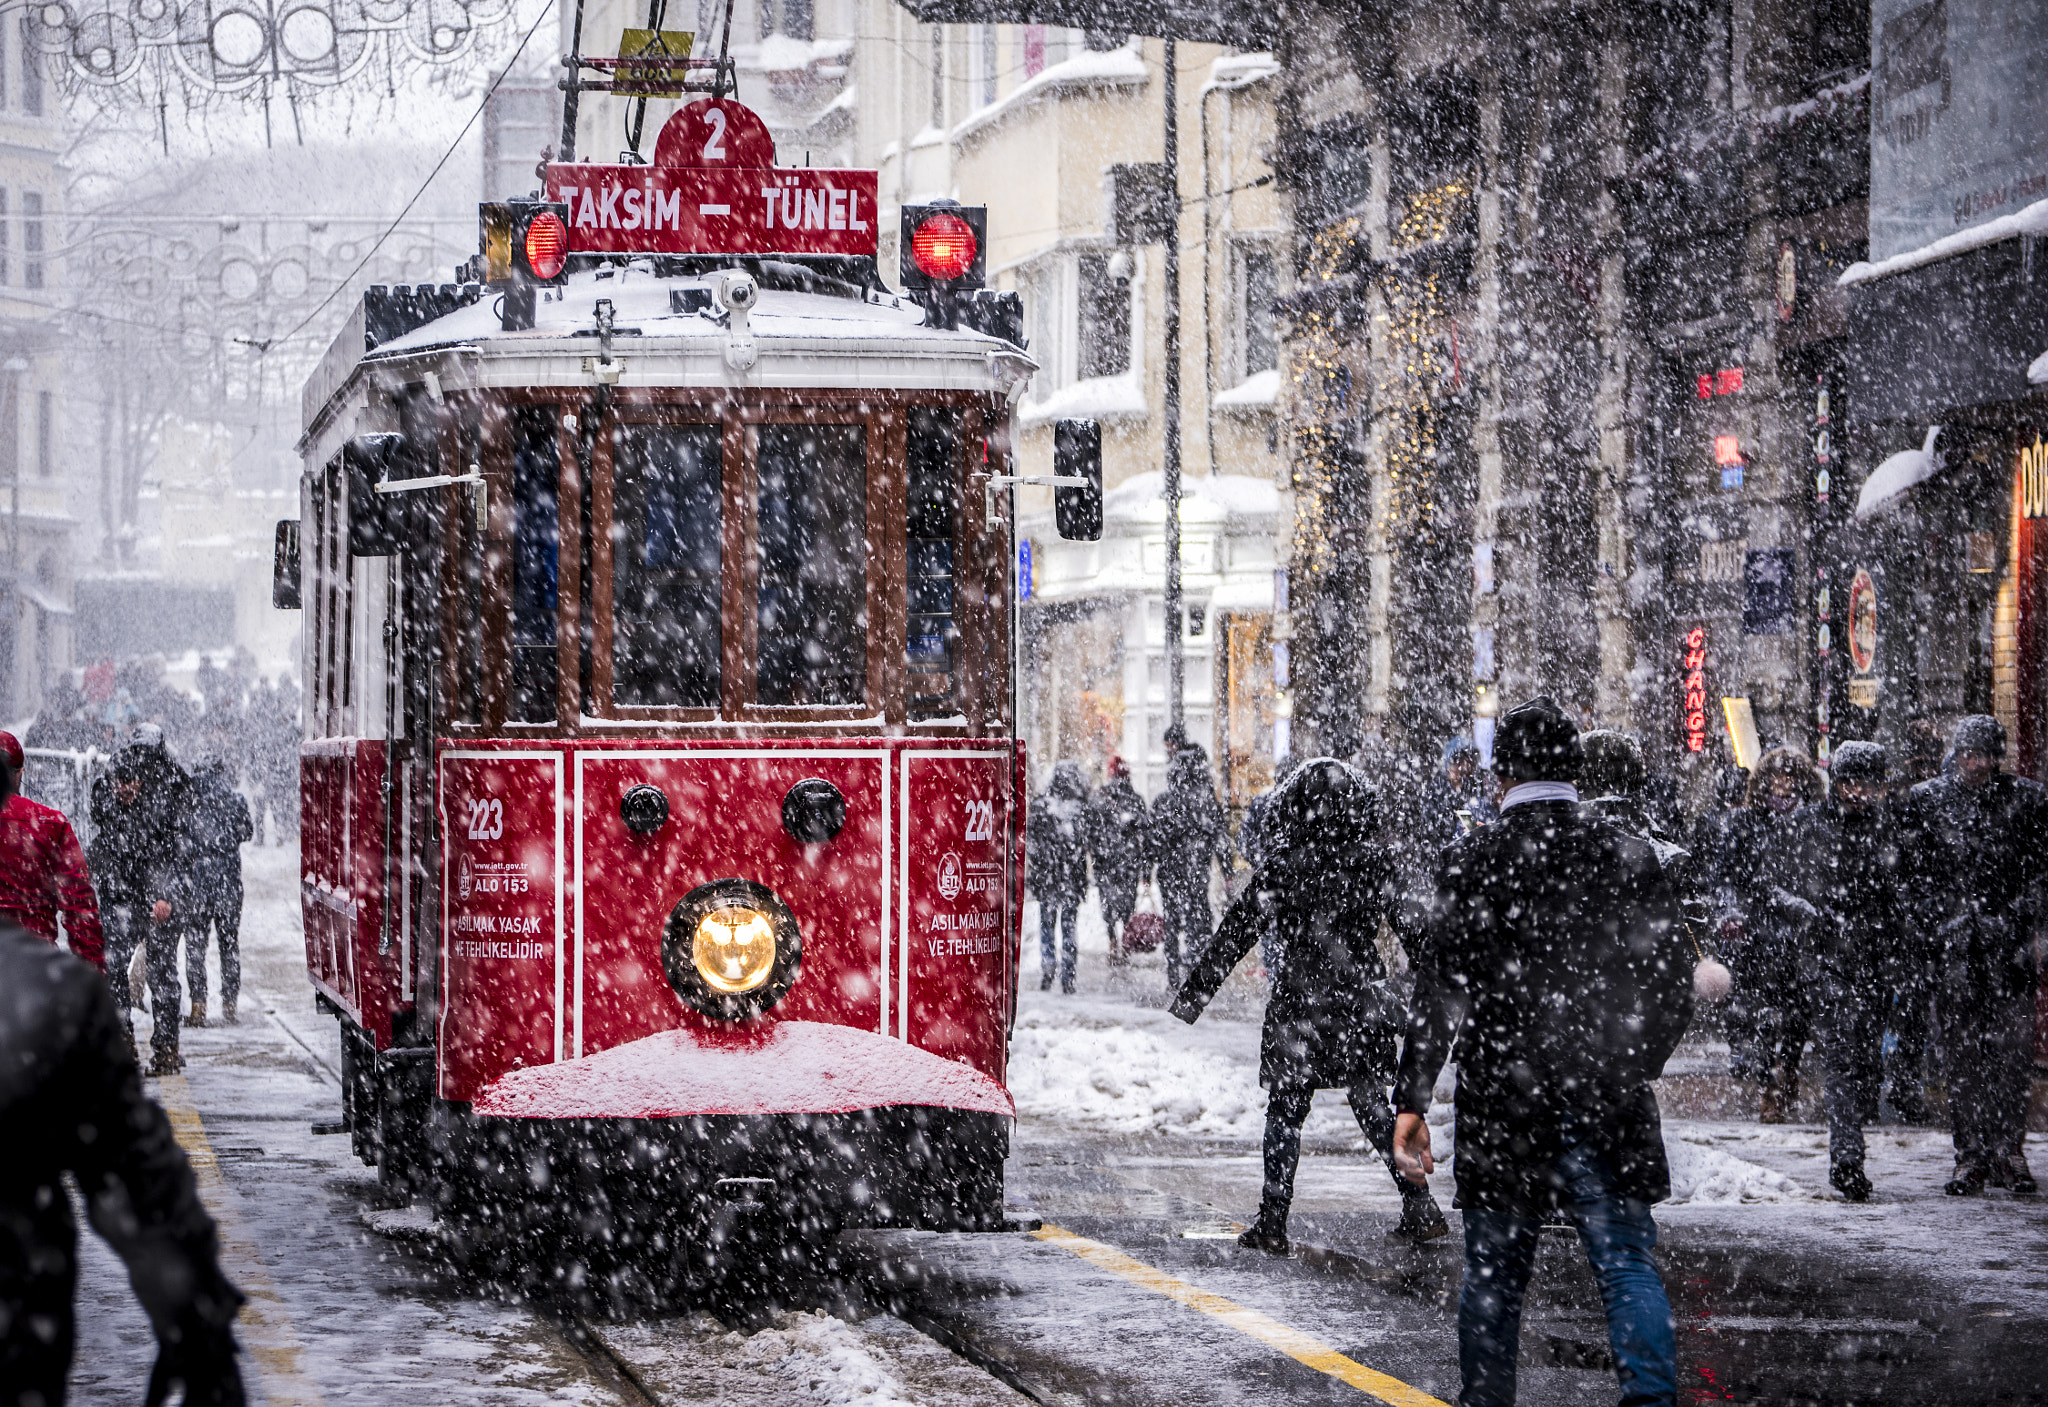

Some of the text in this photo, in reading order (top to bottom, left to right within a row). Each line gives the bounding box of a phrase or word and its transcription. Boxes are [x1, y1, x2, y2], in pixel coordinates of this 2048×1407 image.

[703, 108, 726, 159] 2
[559, 177, 680, 231] TAKSİM
[761, 176, 867, 231] TÜNEL
[1686, 628, 1706, 751] CHANGE
[468, 798, 503, 840] 223
[965, 799, 993, 841] 223
[474, 862, 528, 871] www.iett.gov.tr
[474, 878, 529, 892] ALO 153
[965, 878, 986, 891] ALO
[457, 915, 541, 933] ASILMAK YASAK
[930, 913, 981, 931] ASILMAK
[465, 938, 544, 959] TEHLİKELİDİR
[927, 936, 945, 957] VE
